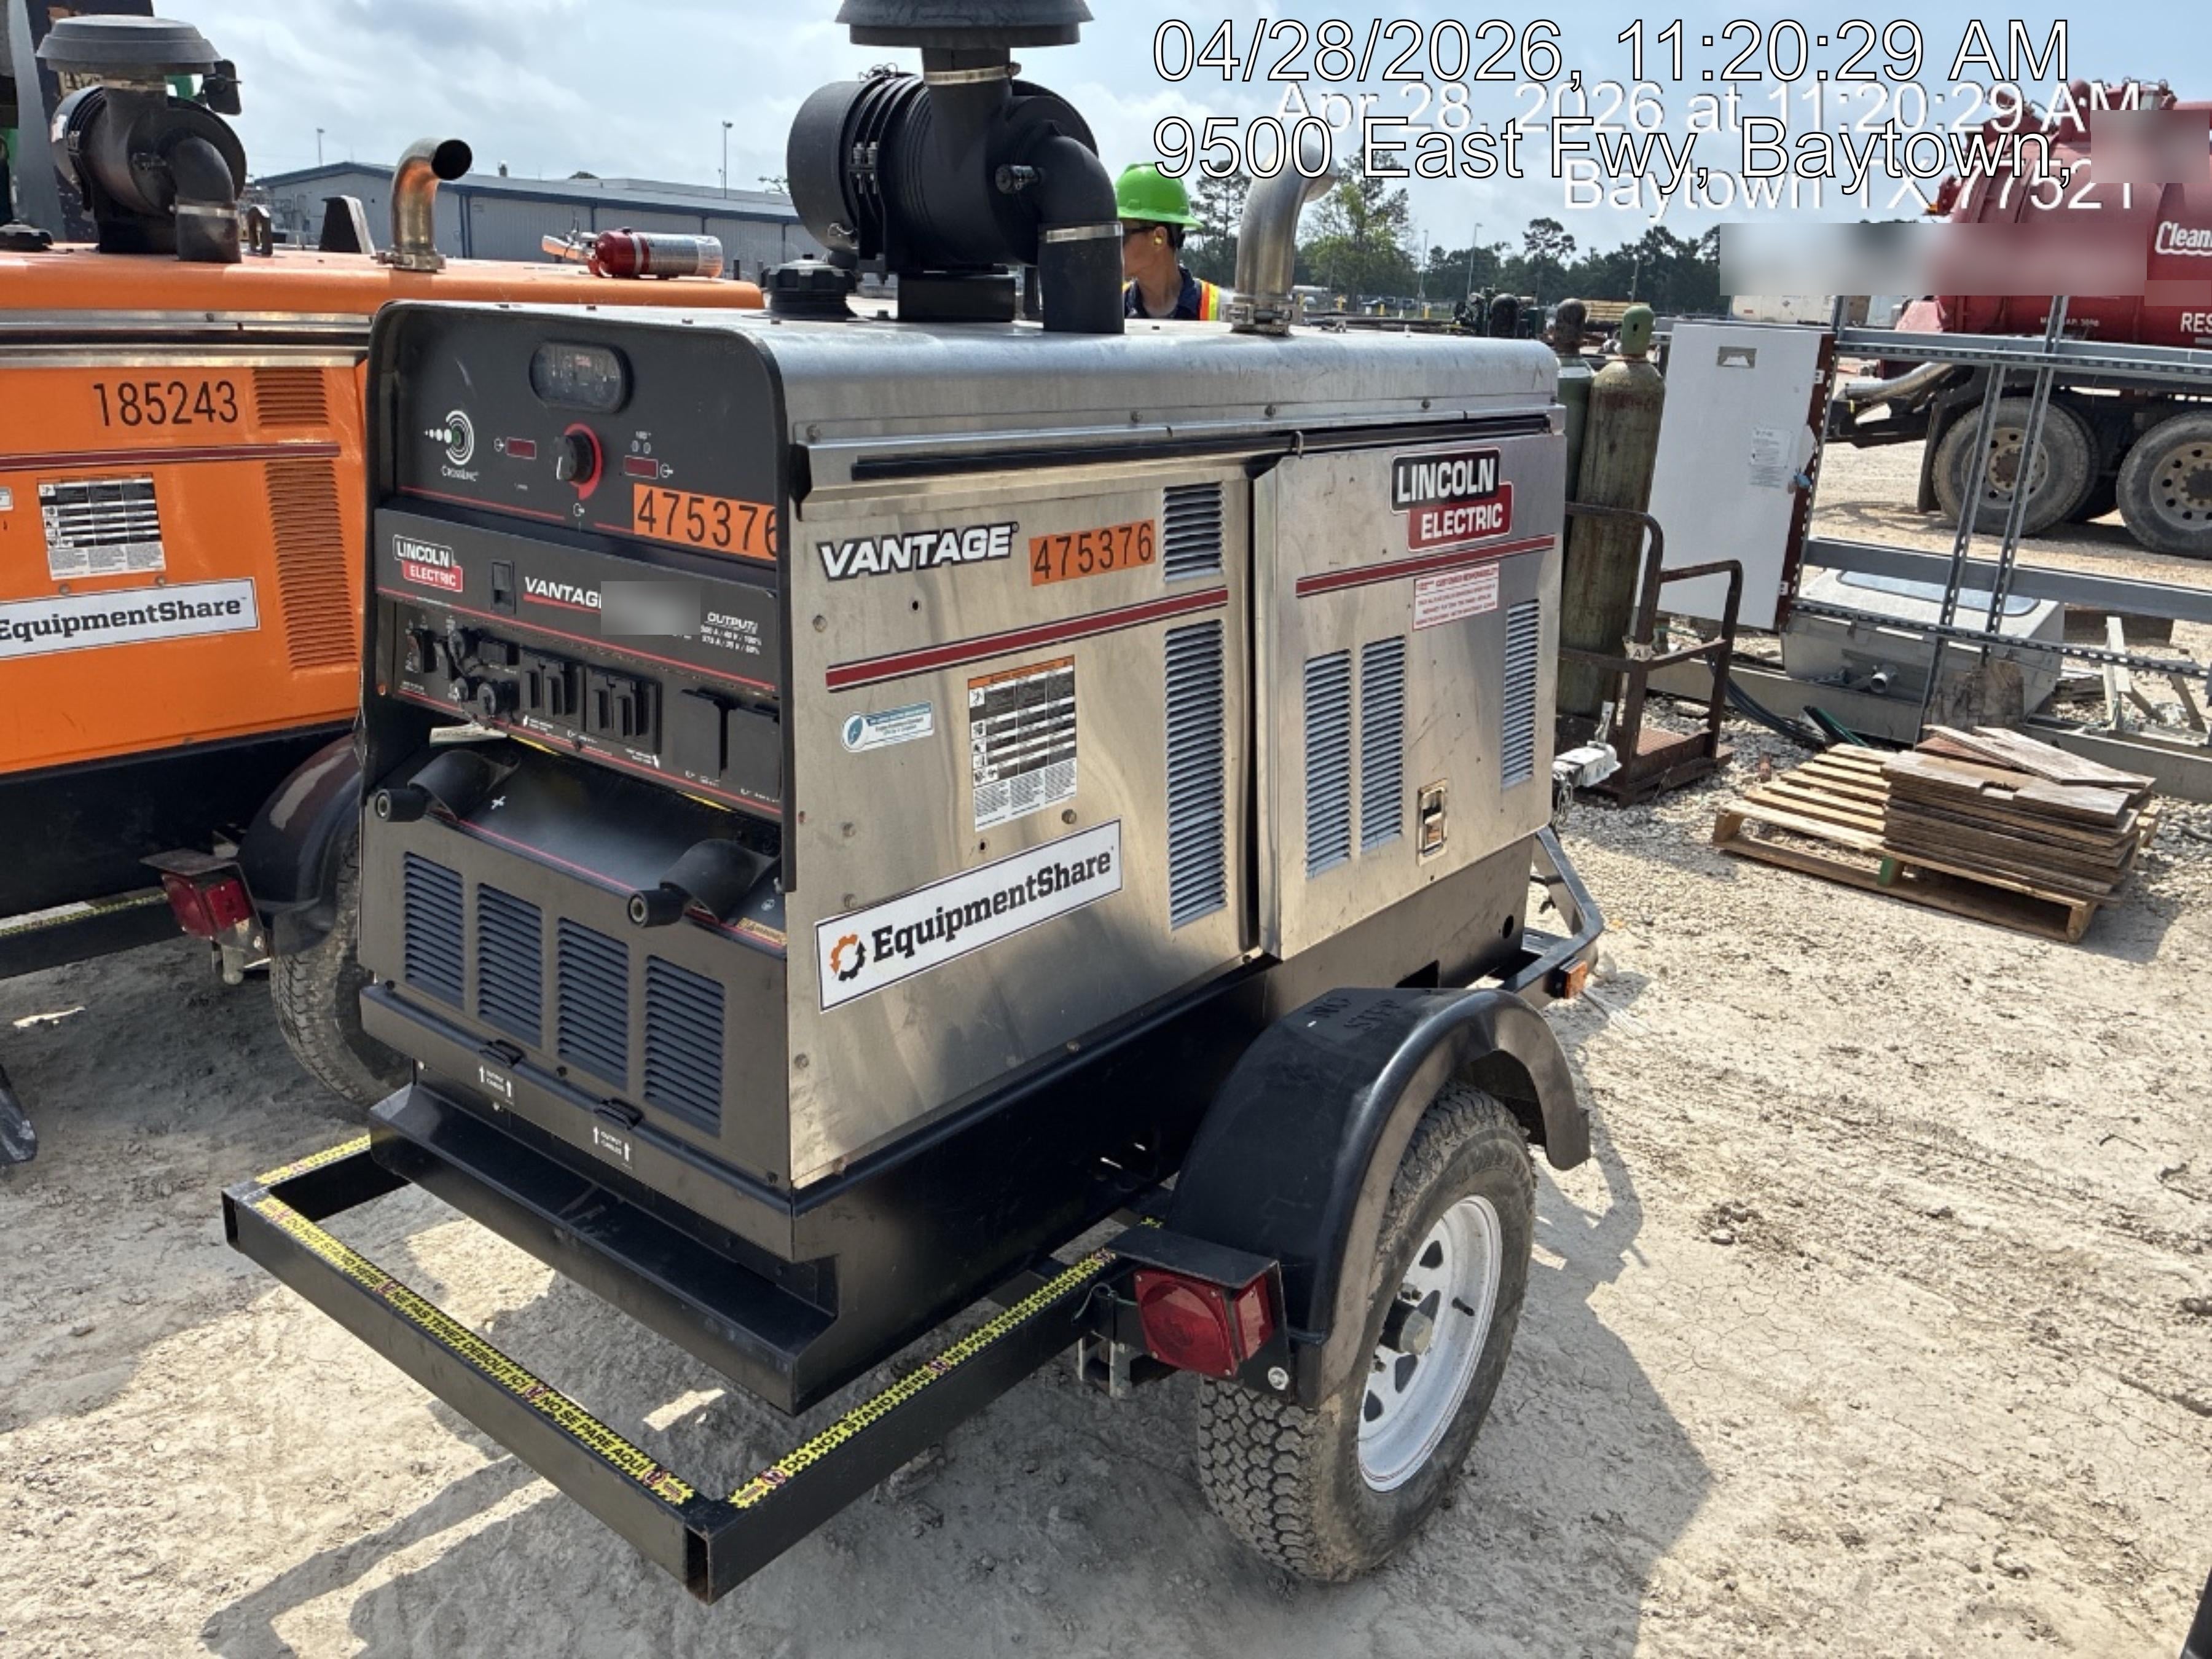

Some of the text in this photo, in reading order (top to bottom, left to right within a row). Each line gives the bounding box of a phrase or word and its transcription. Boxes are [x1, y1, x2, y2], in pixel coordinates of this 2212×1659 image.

[93, 382, 238, 426] 185243
[1397, 459, 1495, 503] LINCOLN
[637, 489, 777, 557] 475376
[1421, 503, 1502, 540] ELECTRIC
[396, 541, 450, 568] LINCOLN
[820, 525, 1013, 578] VANTAGE
[1033, 522, 1152, 580] 475376
[410, 565, 456, 586] ELECTRIC
[525, 576, 601, 608] VANTAG
[0, 600, 241, 643] EquipmentShare
[873, 850, 1111, 962] EquipmentShare
[538, 1395, 563, 1414] NO
[557, 1408, 582, 1427] SE
[575, 1421, 616, 1450] PARE
[782, 1450, 811, 1472] DO
[809, 1429, 844, 1454] NOT
[842, 1395, 894, 1432] STAND
